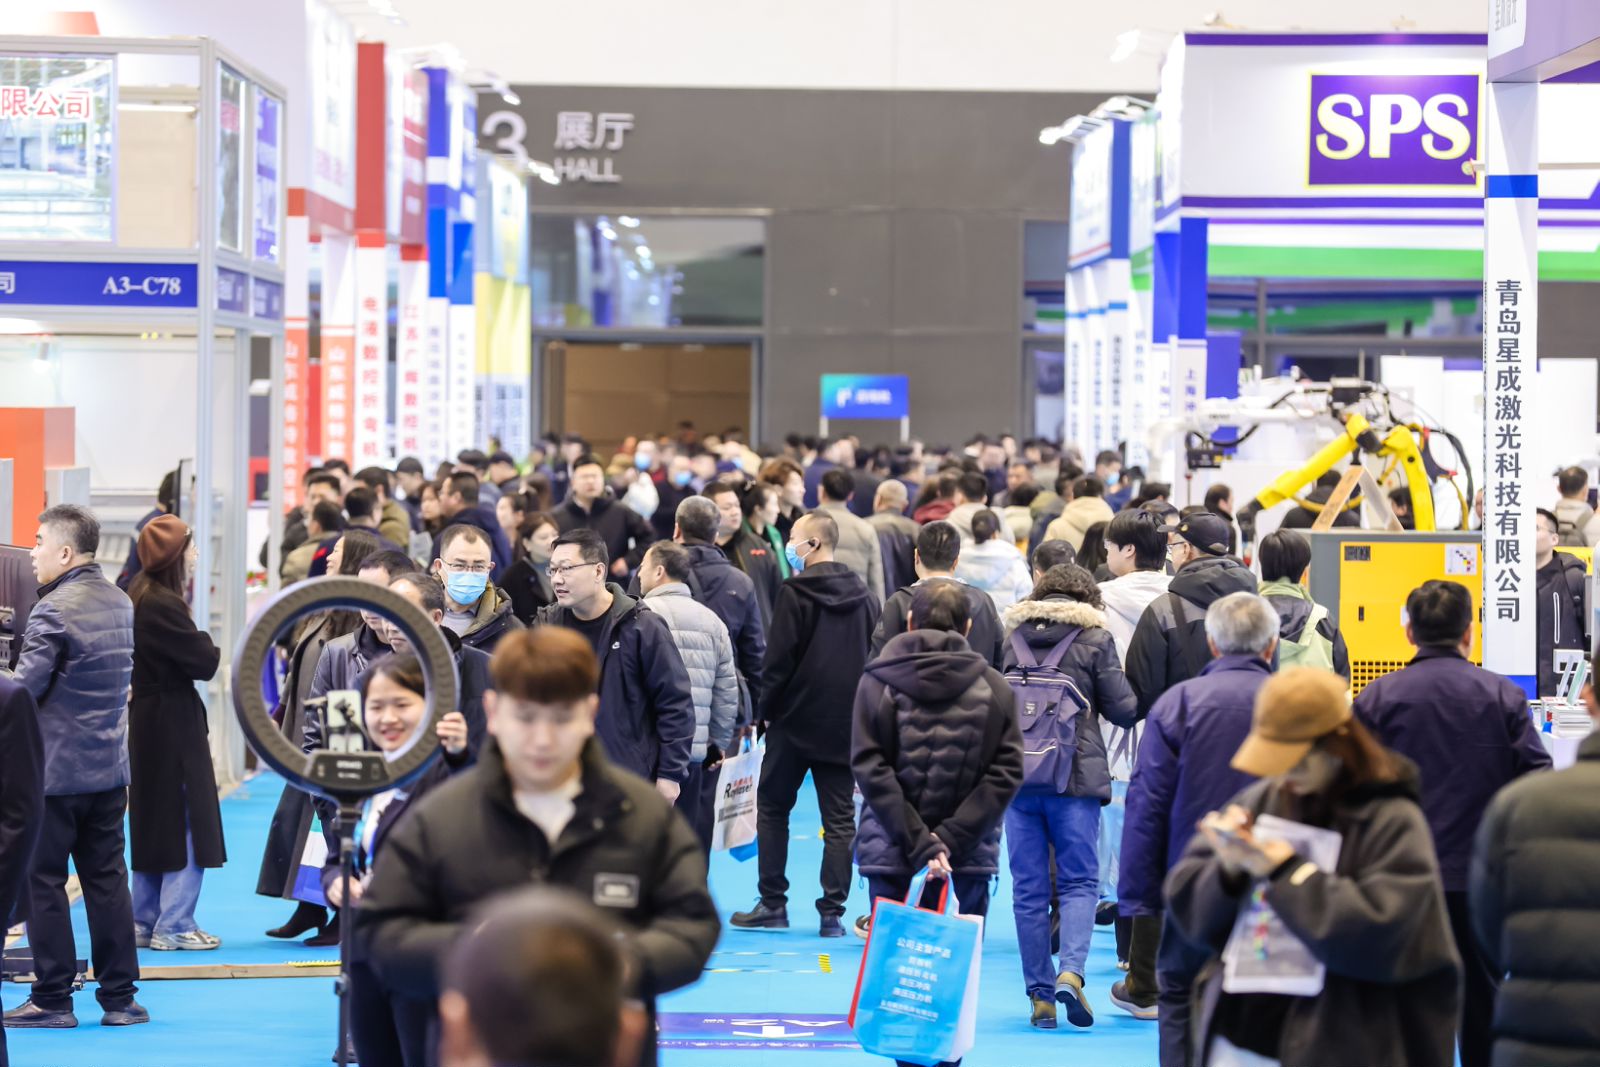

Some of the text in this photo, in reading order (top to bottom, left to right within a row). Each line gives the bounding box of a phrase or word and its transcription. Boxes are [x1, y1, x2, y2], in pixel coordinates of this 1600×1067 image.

[481, 110, 530, 170] 3
[553, 110, 635, 151] 展厅
[1315, 93, 1472, 161] SPS
[554, 156, 622, 183] HALL
[1494, 279, 1523, 623] 青岛星成激光科技有限公司
